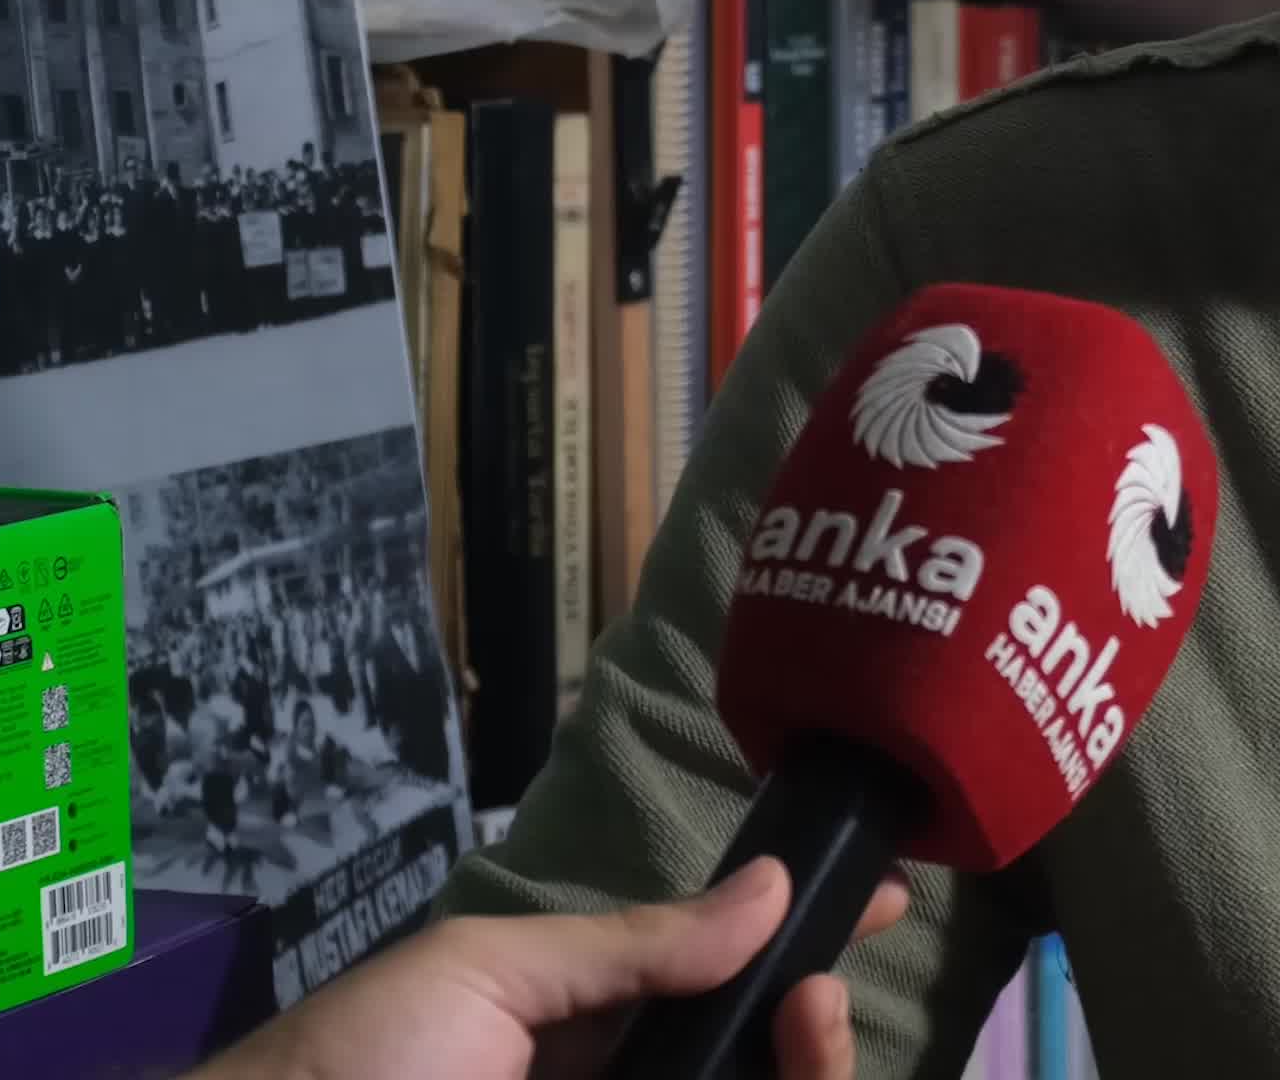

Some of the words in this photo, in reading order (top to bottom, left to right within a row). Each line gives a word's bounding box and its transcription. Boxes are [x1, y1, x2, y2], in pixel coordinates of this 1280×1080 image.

[751, 488, 986, 602] anka
[838, 583, 963, 638] AJANSI
[984, 632, 1048, 730] HABER
[1008, 584, 1126, 770] anka
